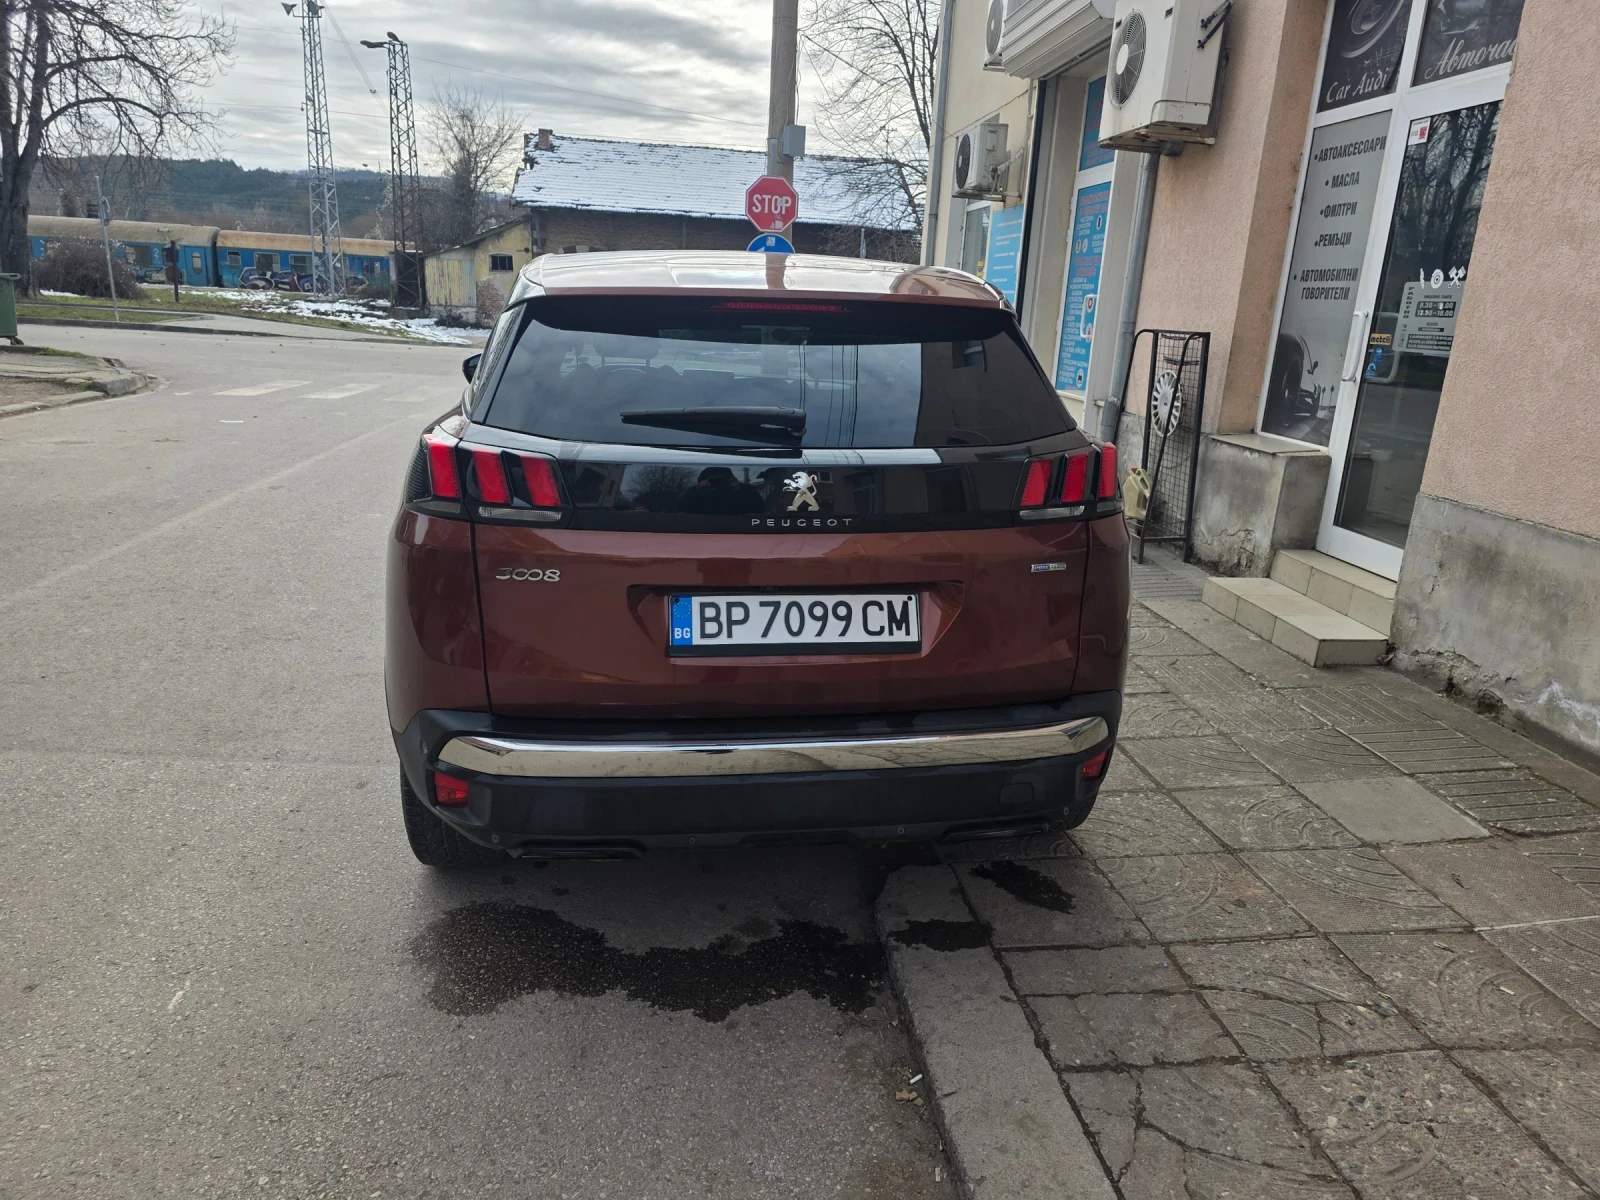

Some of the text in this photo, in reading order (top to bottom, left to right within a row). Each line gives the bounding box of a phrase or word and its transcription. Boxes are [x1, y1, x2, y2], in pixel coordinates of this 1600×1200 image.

[1326, 81, 1351, 104] Car
[1318, 135, 1387, 162] АВТОАКСЕСОАРИ
[1331, 171, 1360, 188] МАСЛА
[752, 193, 792, 215] STOP
[1323, 201, 1358, 218] ФИЛТРИ
[1318, 231, 1353, 248] РЕМЪЦИ
[1300, 267, 1359, 282] АВТОМОБИЛНИ
[1301, 286, 1351, 300] ГОВОРИТЕЛИ
[751, 518, 852, 527] PEUGEOT
[495, 567, 561, 582] 3008
[699, 600, 912, 639] BP 7099 CM
[674, 627, 691, 640] BG
